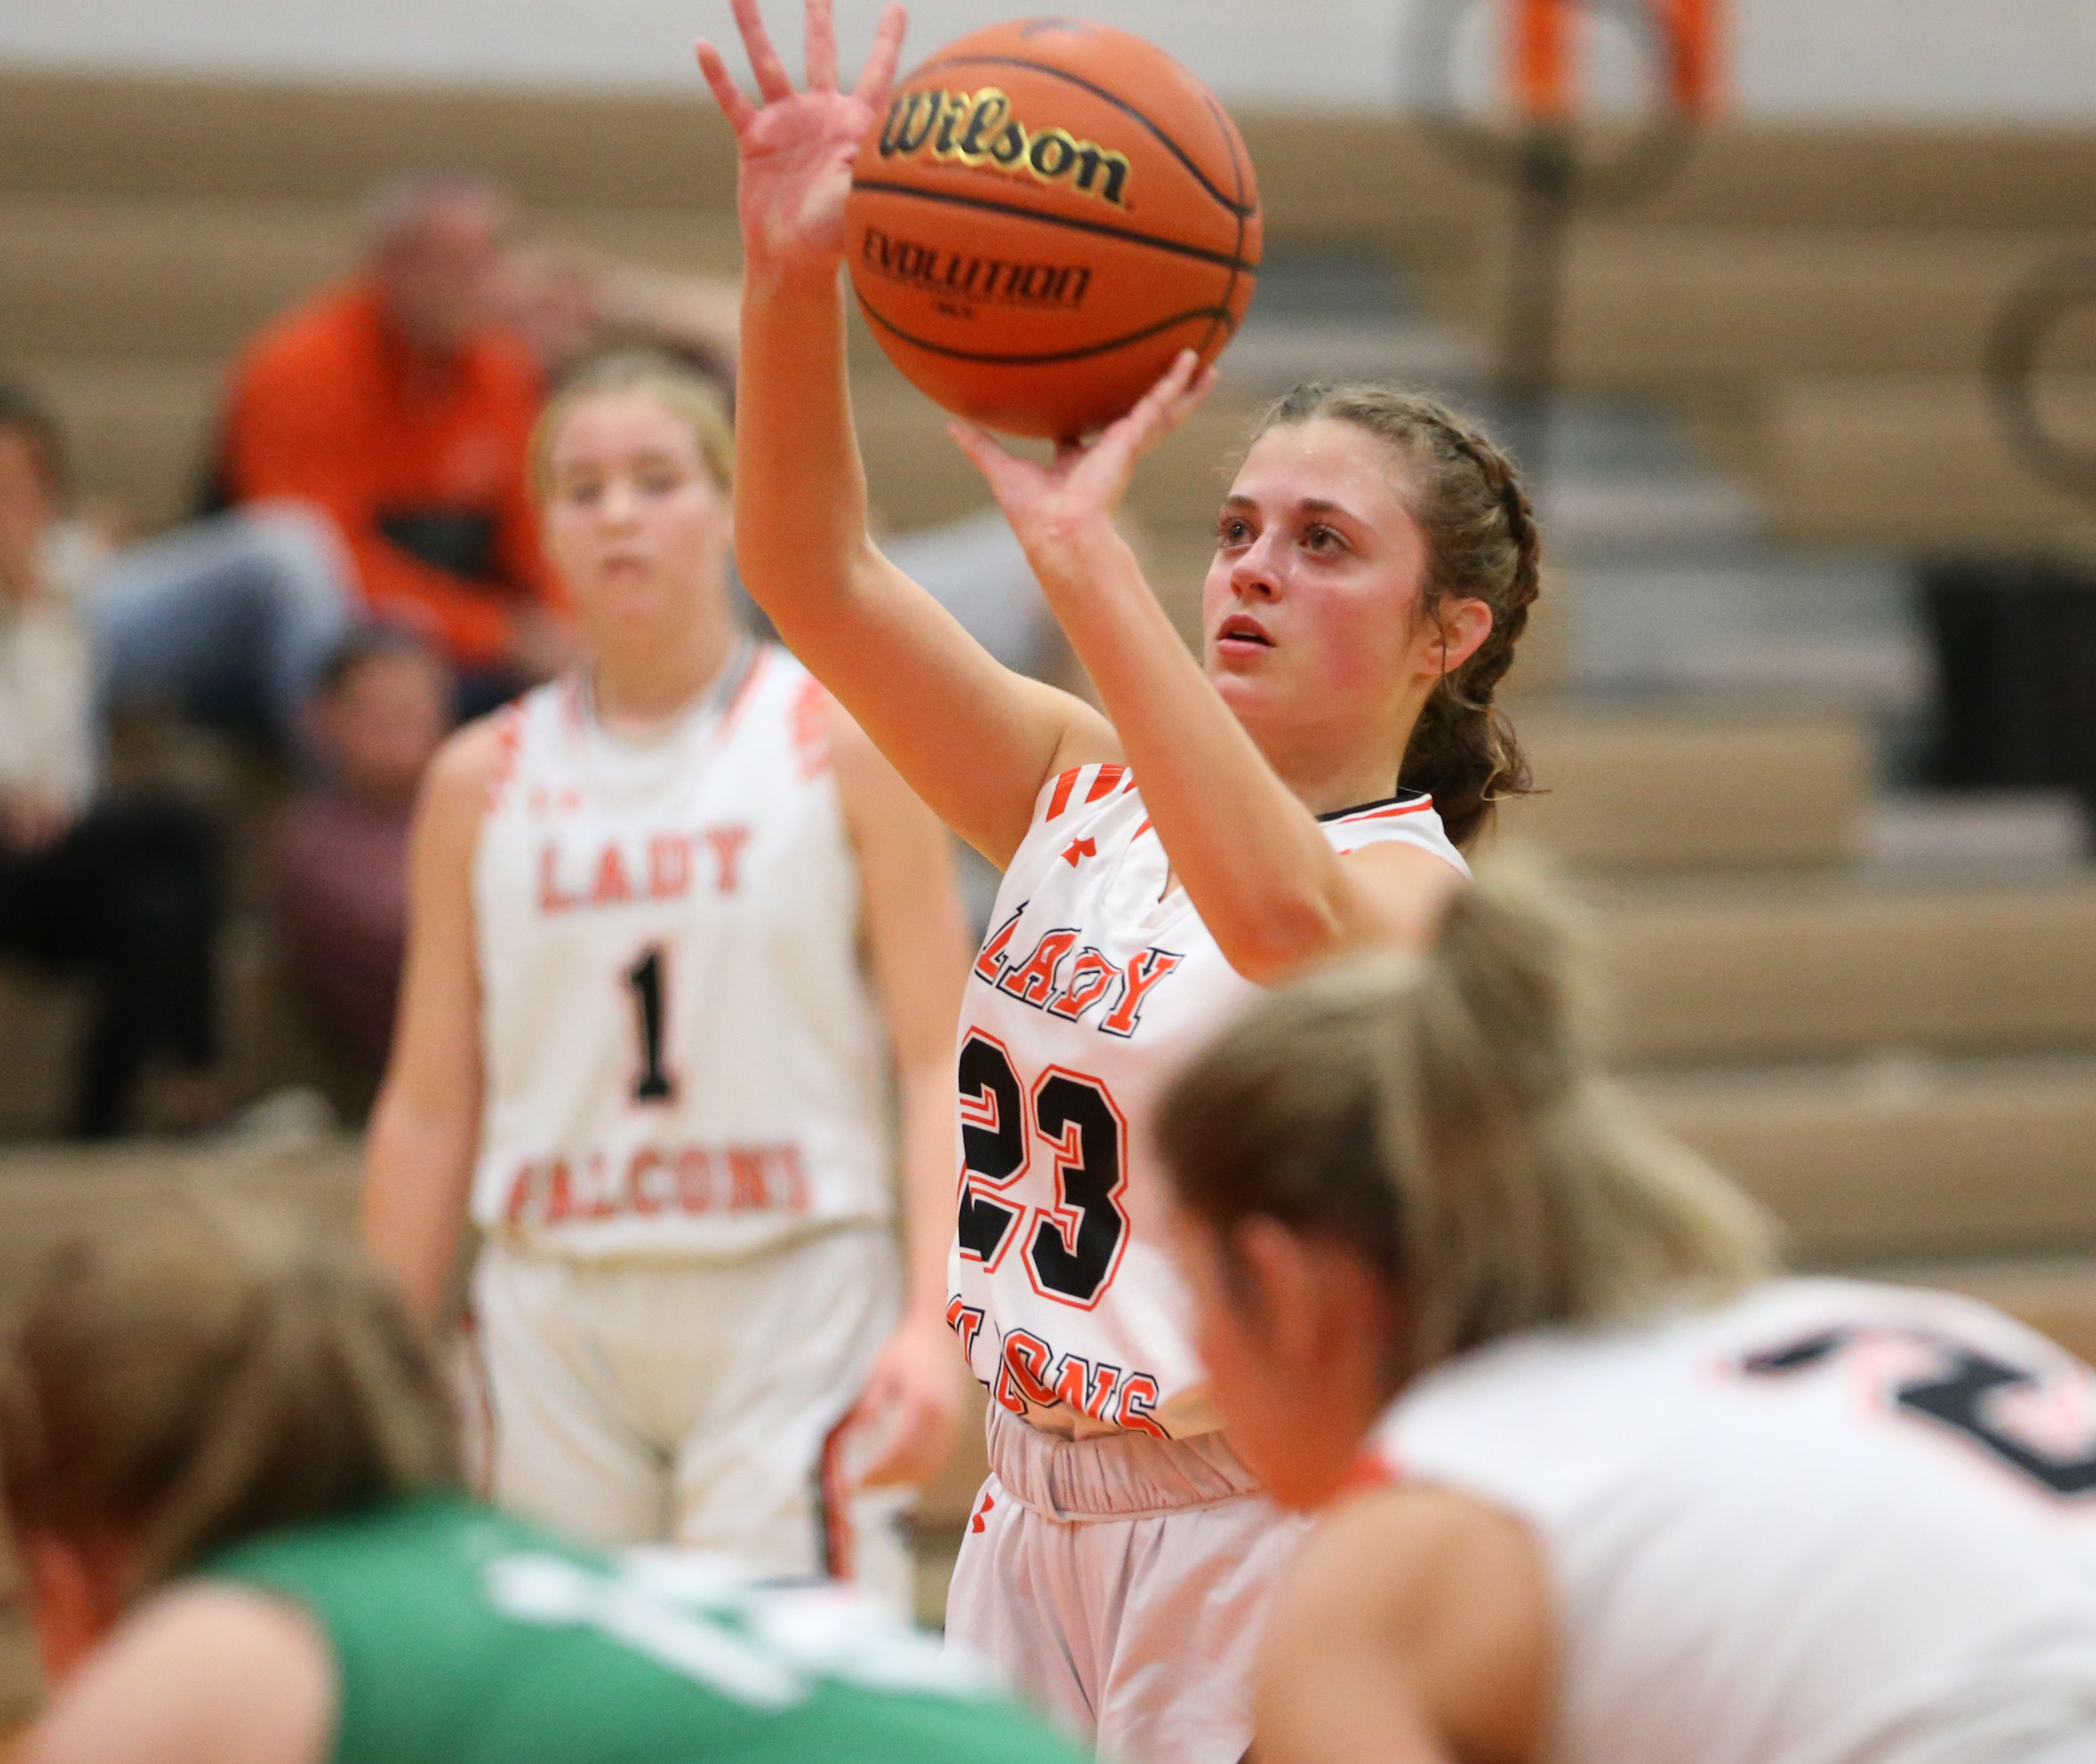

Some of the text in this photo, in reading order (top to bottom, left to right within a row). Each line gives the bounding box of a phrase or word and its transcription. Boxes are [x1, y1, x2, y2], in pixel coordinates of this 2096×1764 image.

[879, 86, 1132, 212] Wilson
[862, 227, 1093, 306] EVOLUTION
[538, 822, 753, 916] LADY
[622, 939, 677, 1112] 1
[974, 899, 1186, 1039] LADY
[957, 1025, 1130, 1311] 23
